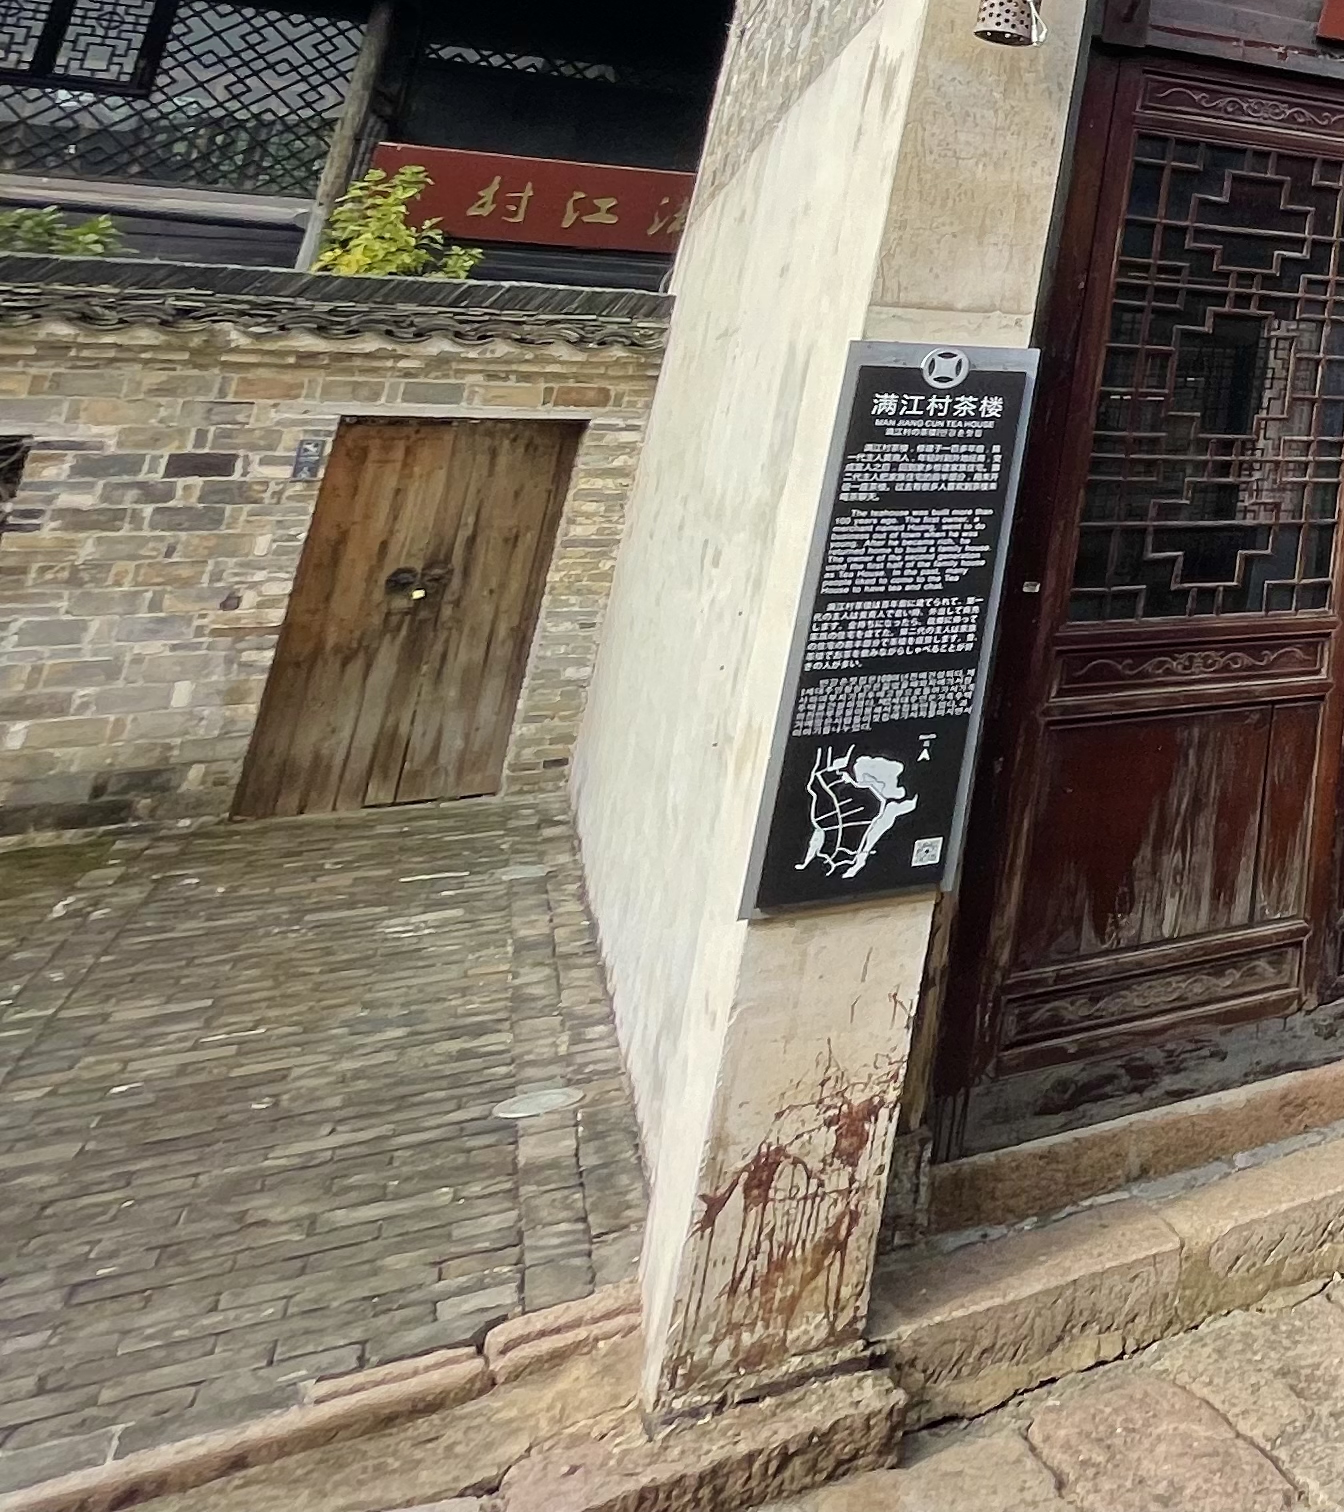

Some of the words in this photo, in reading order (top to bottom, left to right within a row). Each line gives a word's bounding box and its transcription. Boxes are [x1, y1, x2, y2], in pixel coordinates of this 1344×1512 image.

[871, 393, 1004, 418] 满江村茶楼
